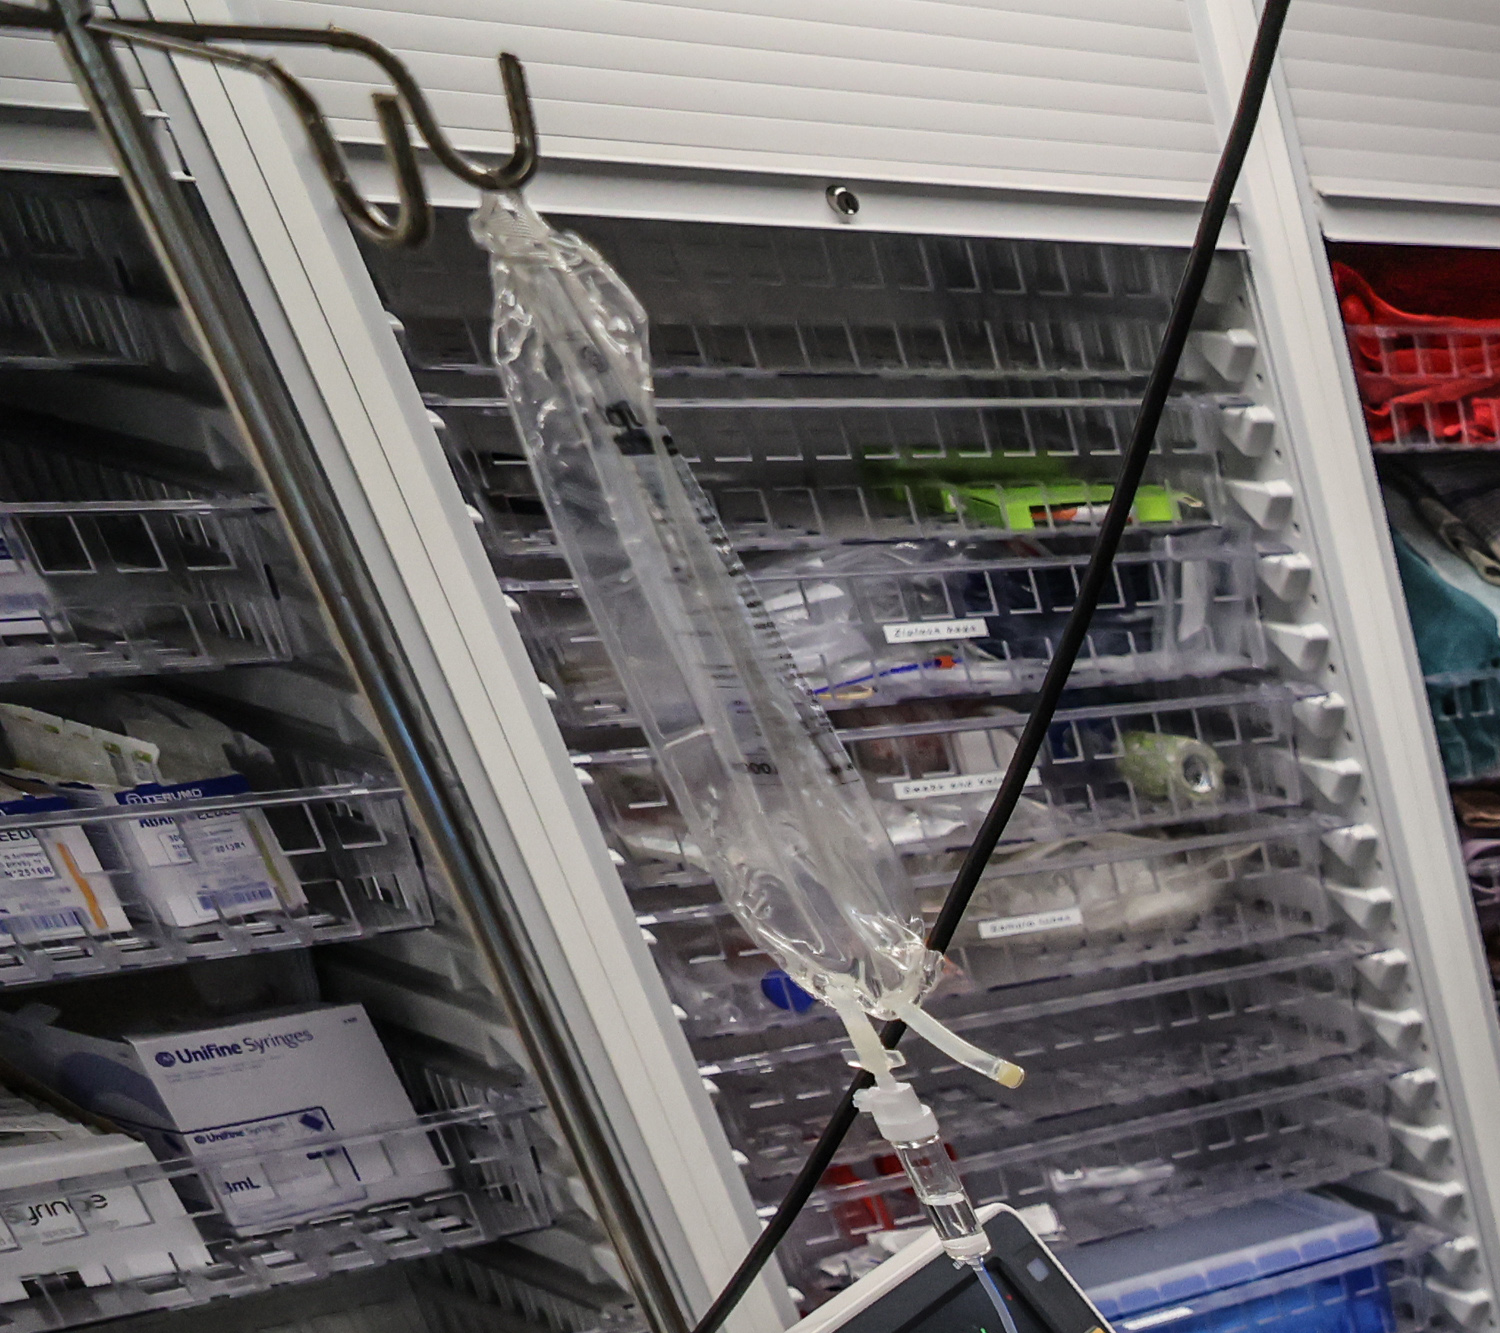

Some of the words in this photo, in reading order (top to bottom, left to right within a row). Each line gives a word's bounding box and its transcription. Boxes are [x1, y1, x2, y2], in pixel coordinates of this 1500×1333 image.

[143, 788, 203, 804] TERUMO
[176, 1041, 243, 1064] Unifine
[243, 1029, 314, 1054] Syringes
[206, 1128, 244, 1143] Unifine
